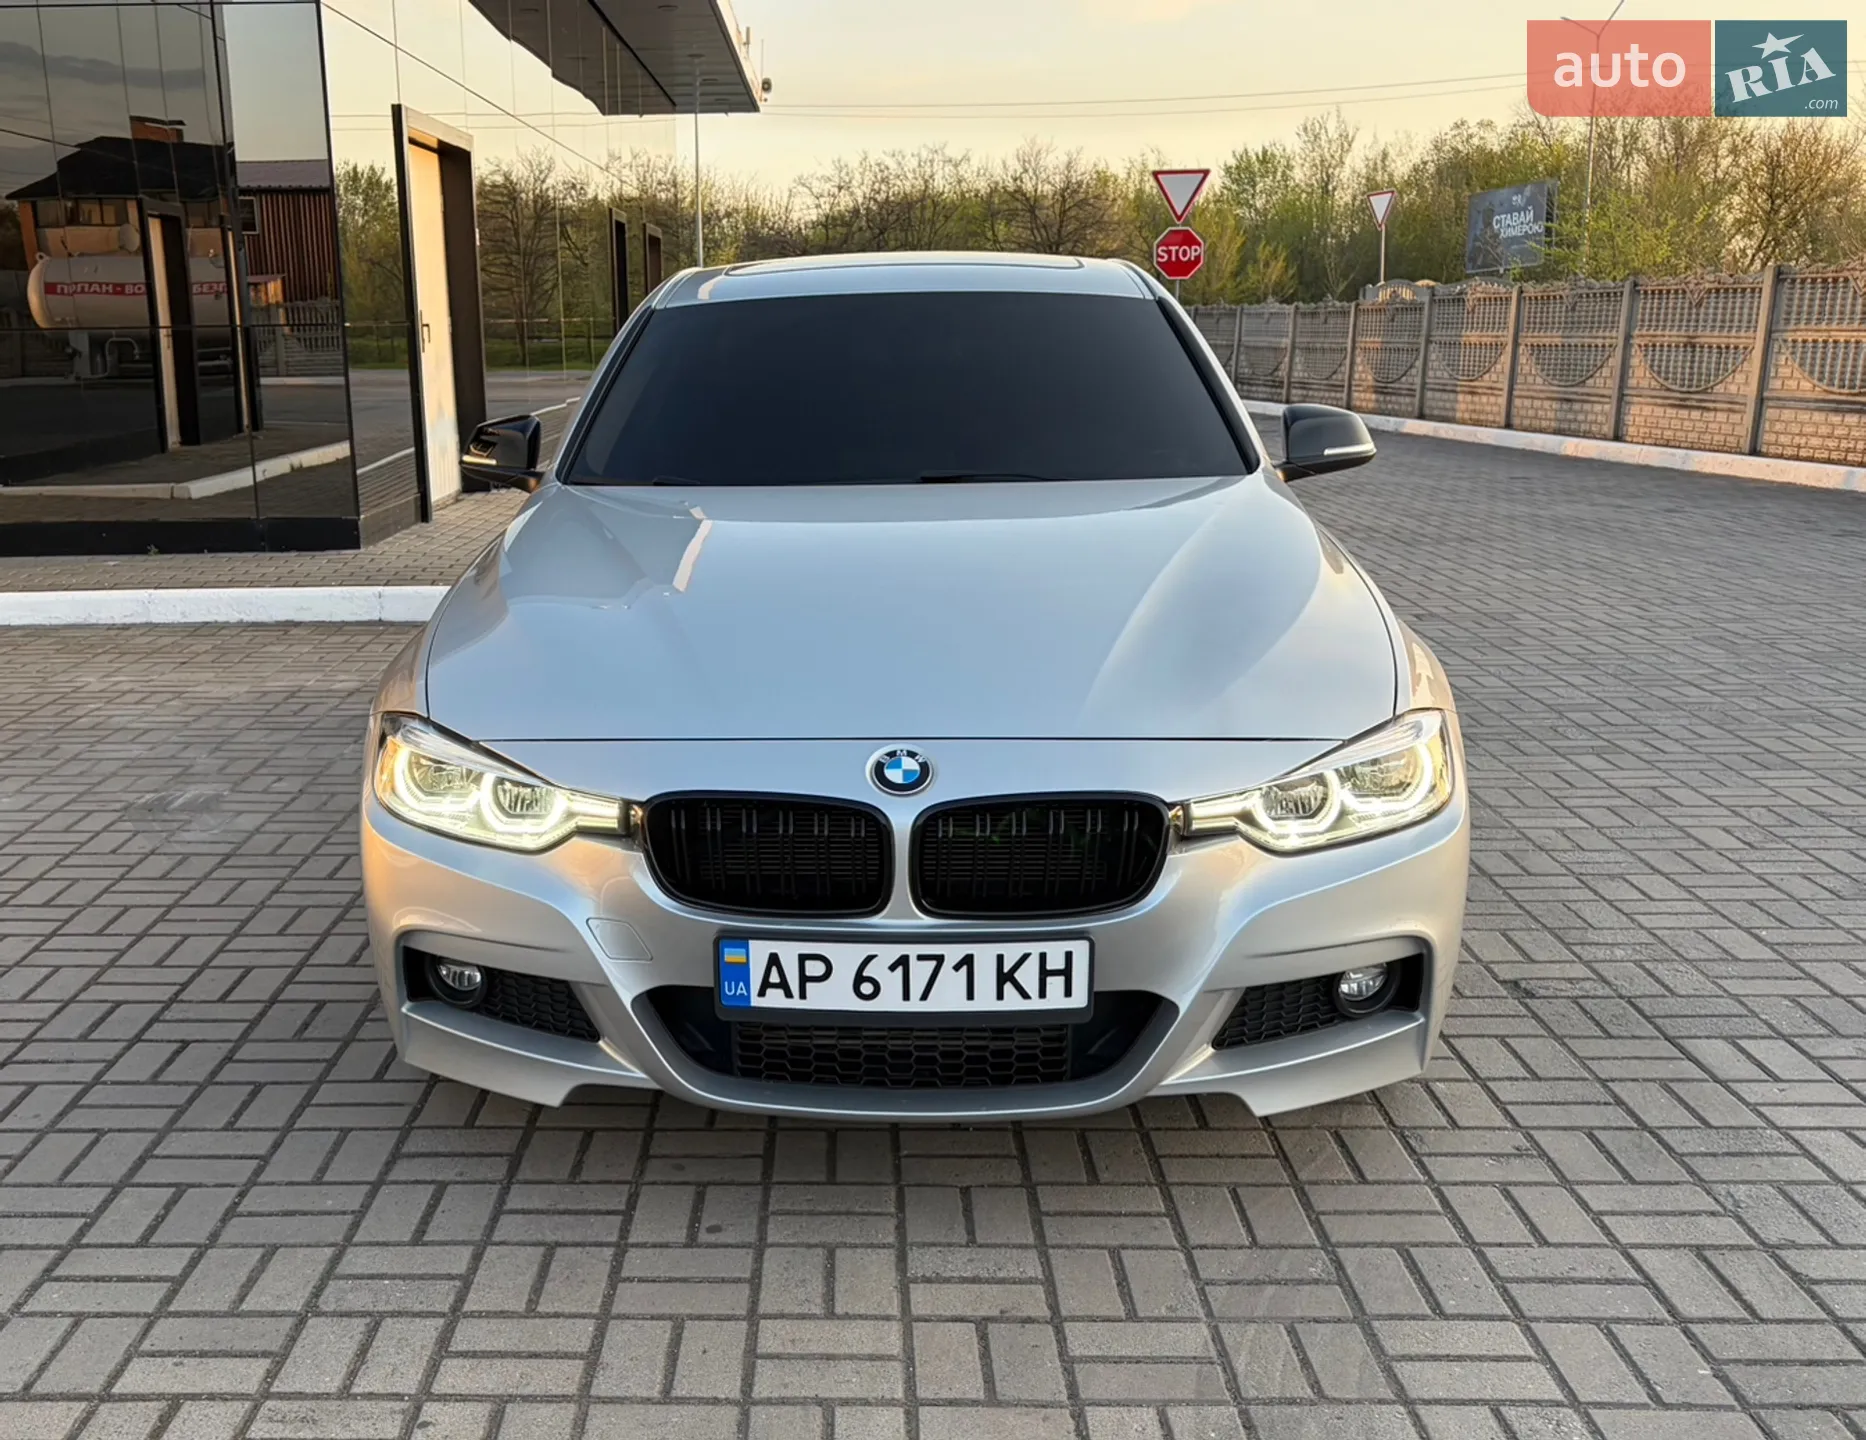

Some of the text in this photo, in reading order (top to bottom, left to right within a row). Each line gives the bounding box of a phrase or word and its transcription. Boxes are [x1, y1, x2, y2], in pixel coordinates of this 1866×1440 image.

[1492, 205, 1535, 229] СТАВАЙ
[1499, 221, 1544, 239] ХИМЕРОЮ
[1157, 245, 1201, 262] STOP
[879, 749, 927, 763] BMW
[757, 950, 1074, 1001] AP 6171 KH
[724, 981, 748, 996] UA
